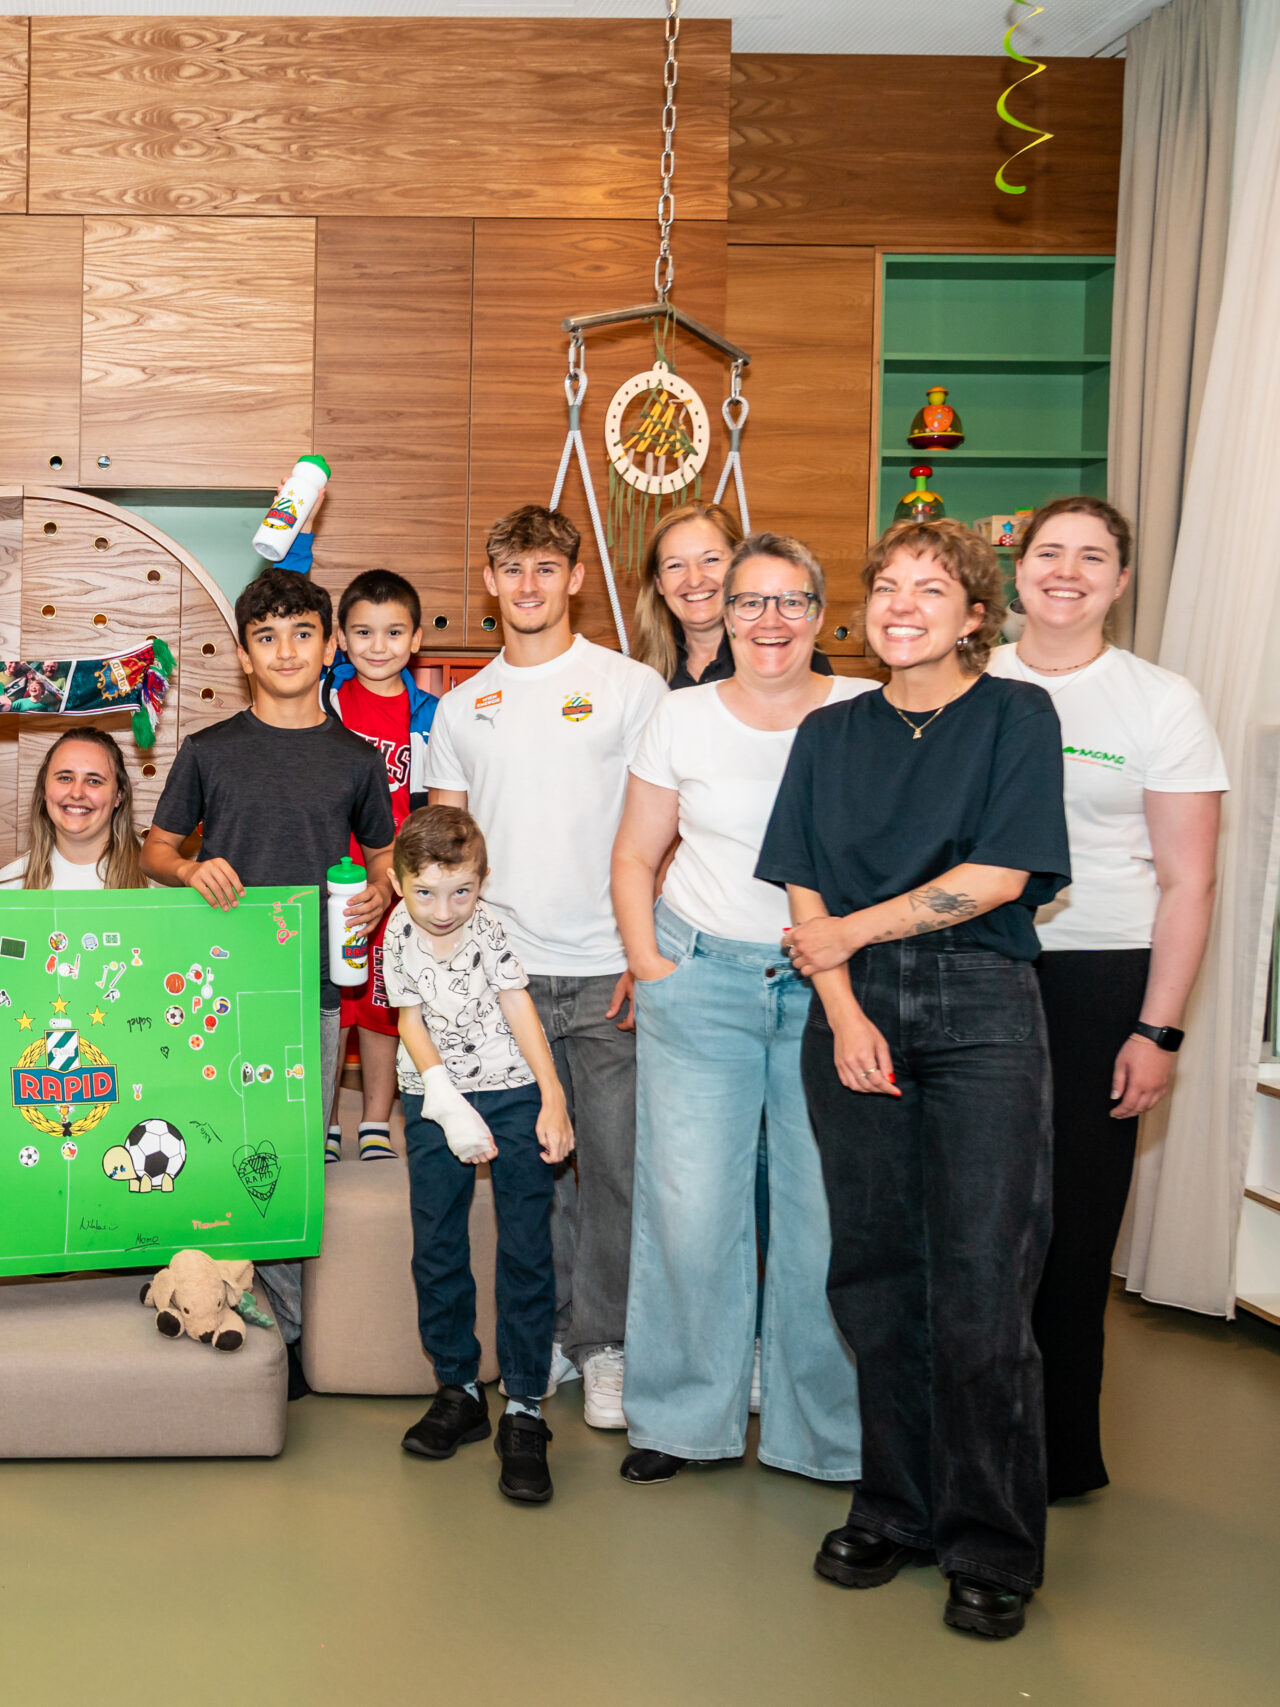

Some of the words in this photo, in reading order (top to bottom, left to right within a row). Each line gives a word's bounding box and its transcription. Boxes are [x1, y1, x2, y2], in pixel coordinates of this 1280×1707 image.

[1078, 748, 1125, 765] MOMO
[20, 1072, 113, 1101] RAPID
[245, 1170, 274, 1185] RAPID
